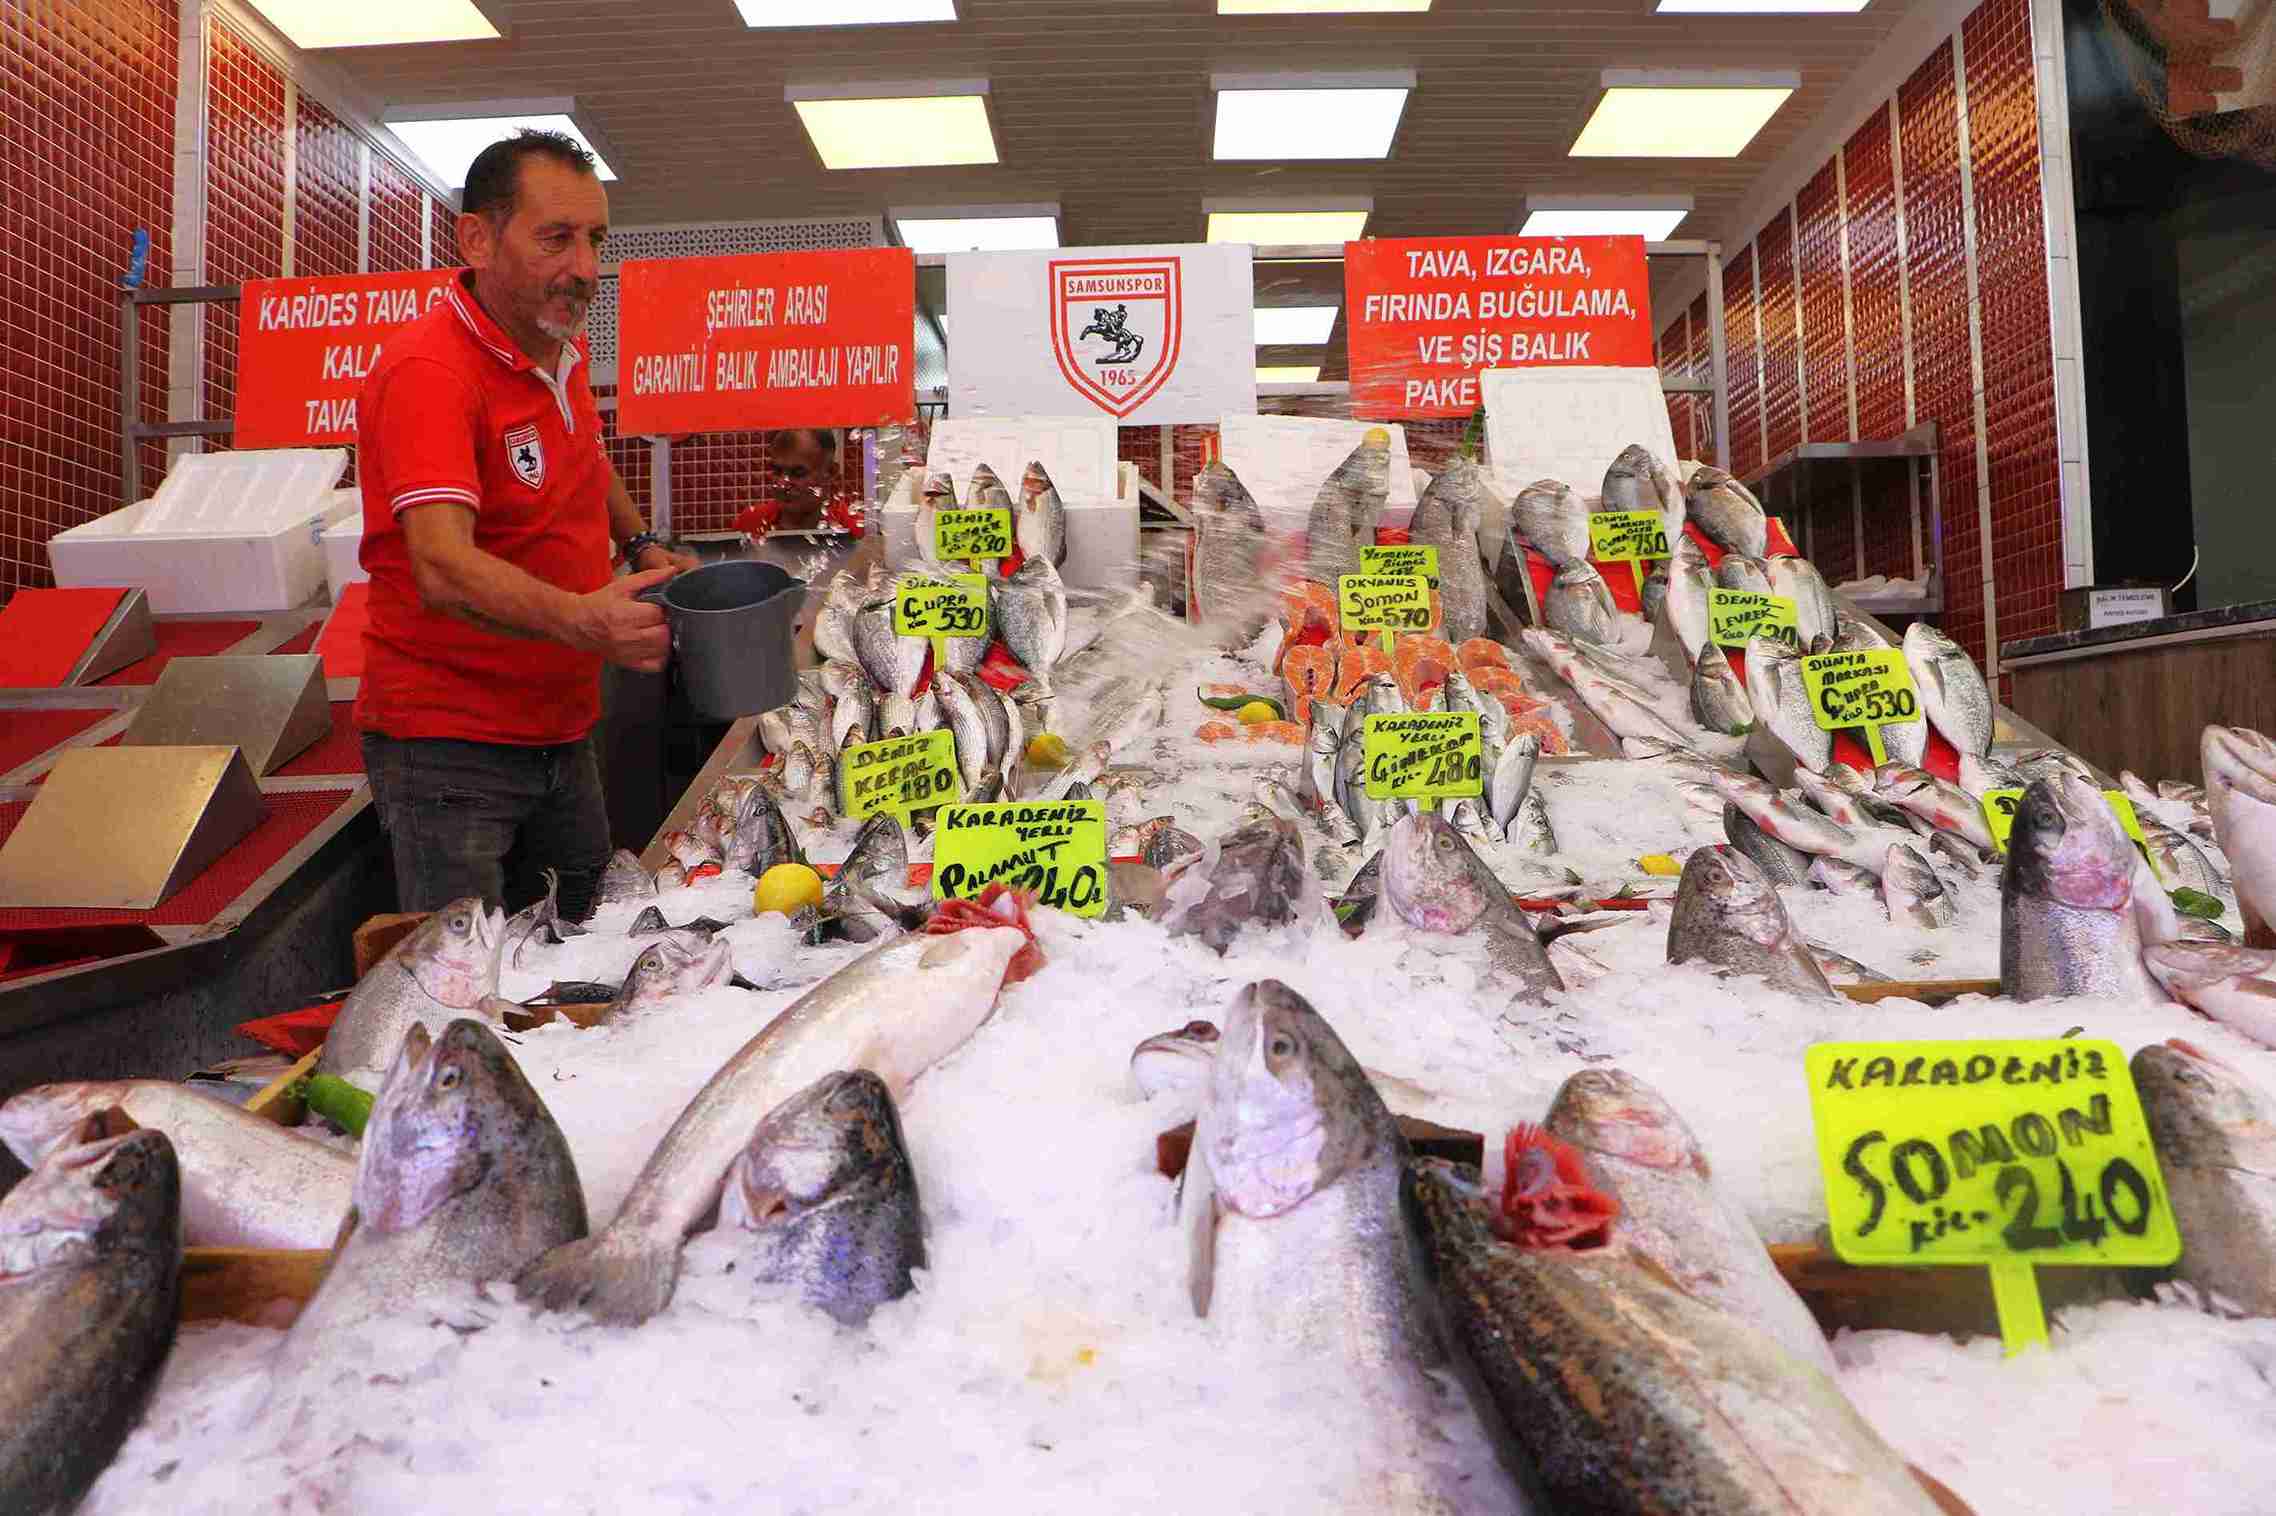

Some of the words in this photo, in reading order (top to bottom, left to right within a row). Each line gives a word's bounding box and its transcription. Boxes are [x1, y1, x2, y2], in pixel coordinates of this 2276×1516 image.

[1406, 249, 1477, 281] TAVA,
[1486, 247, 1591, 279] IZGARA,
[1068, 278, 1162, 293] SAMSUNSPOR
[258, 285, 358, 331] KARİDES
[707, 280, 775, 338] ŞEHİRLER
[784, 285, 828, 325] ARASI
[1364, 292, 1471, 322] FIRINDA
[1479, 284, 1636, 320] BUĞULAMA,
[1418, 335, 1452, 364] VE
[1460, 328, 1502, 368] ŞİŞ
[1511, 332, 1591, 361] BALIK
[633, 345, 707, 395] GARANTİLİ
[715, 351, 758, 391] BALIK
[766, 347, 839, 388] AMBALAJI
[846, 345, 899, 385] YAPILIR
[1100, 369, 1136, 386] 1965
[1405, 378, 1480, 408] PAKE
[306, 398, 358, 434] TAVA
[1346, 578, 1417, 589] OKYANUS
[1345, 590, 1419, 617] SOMON
[1715, 593, 1785, 609] DENİZ
[935, 607, 984, 631] 530
[1383, 607, 1430, 627] 570
[1714, 608, 1778, 634] LEVREK
[1808, 653, 1866, 671] DÜNYA
[1822, 665, 1889, 685] MARKASI
[1865, 688, 1915, 720] 530
[1373, 716, 1465, 733] KARADENİZ
[1424, 751, 1480, 787] 480
[898, 768, 953, 804] 180
[947, 804, 1098, 830] KARADENİZ
[1015, 824, 1073, 842] YERLİ
[940, 840, 1071, 900] PALAMUT
[1826, 1047, 2108, 1090] KARADENİZ
[1842, 1092, 2113, 1238] SOMON
[1995, 1155, 2151, 1252] 240
